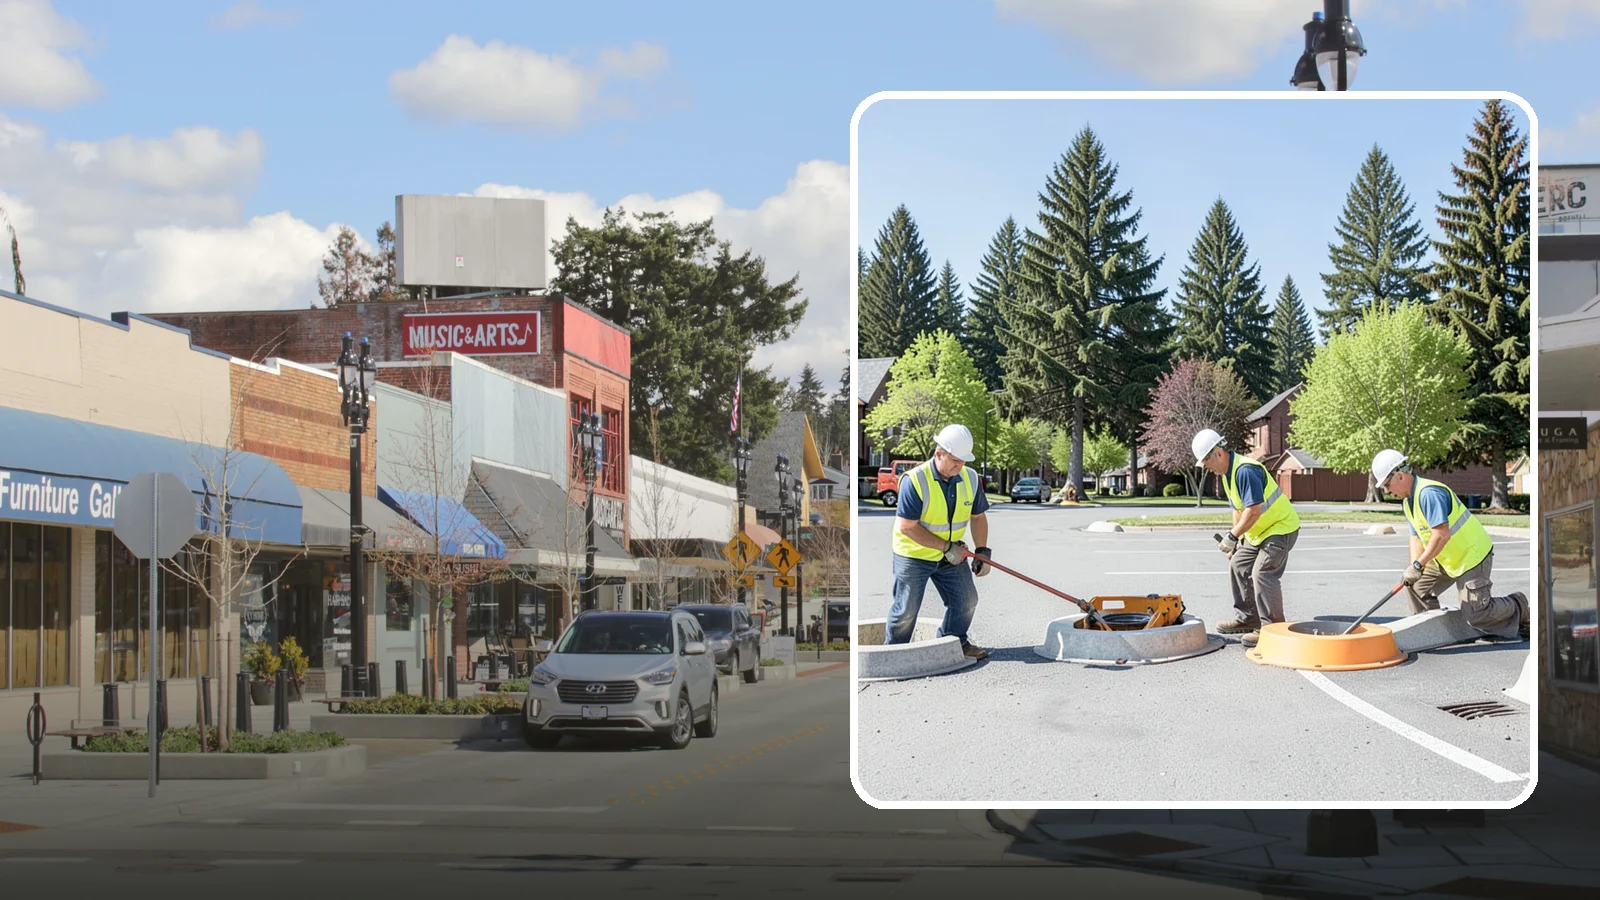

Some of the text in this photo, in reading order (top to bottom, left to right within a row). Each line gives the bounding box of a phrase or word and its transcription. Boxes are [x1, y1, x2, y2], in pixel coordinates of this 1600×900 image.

[408, 323, 520, 349] MUSIC&ARTS
[1540, 427, 1578, 437] UGA
[0, 471, 122, 519] Furniture Gal
[453, 563, 479, 575] SUSHI
